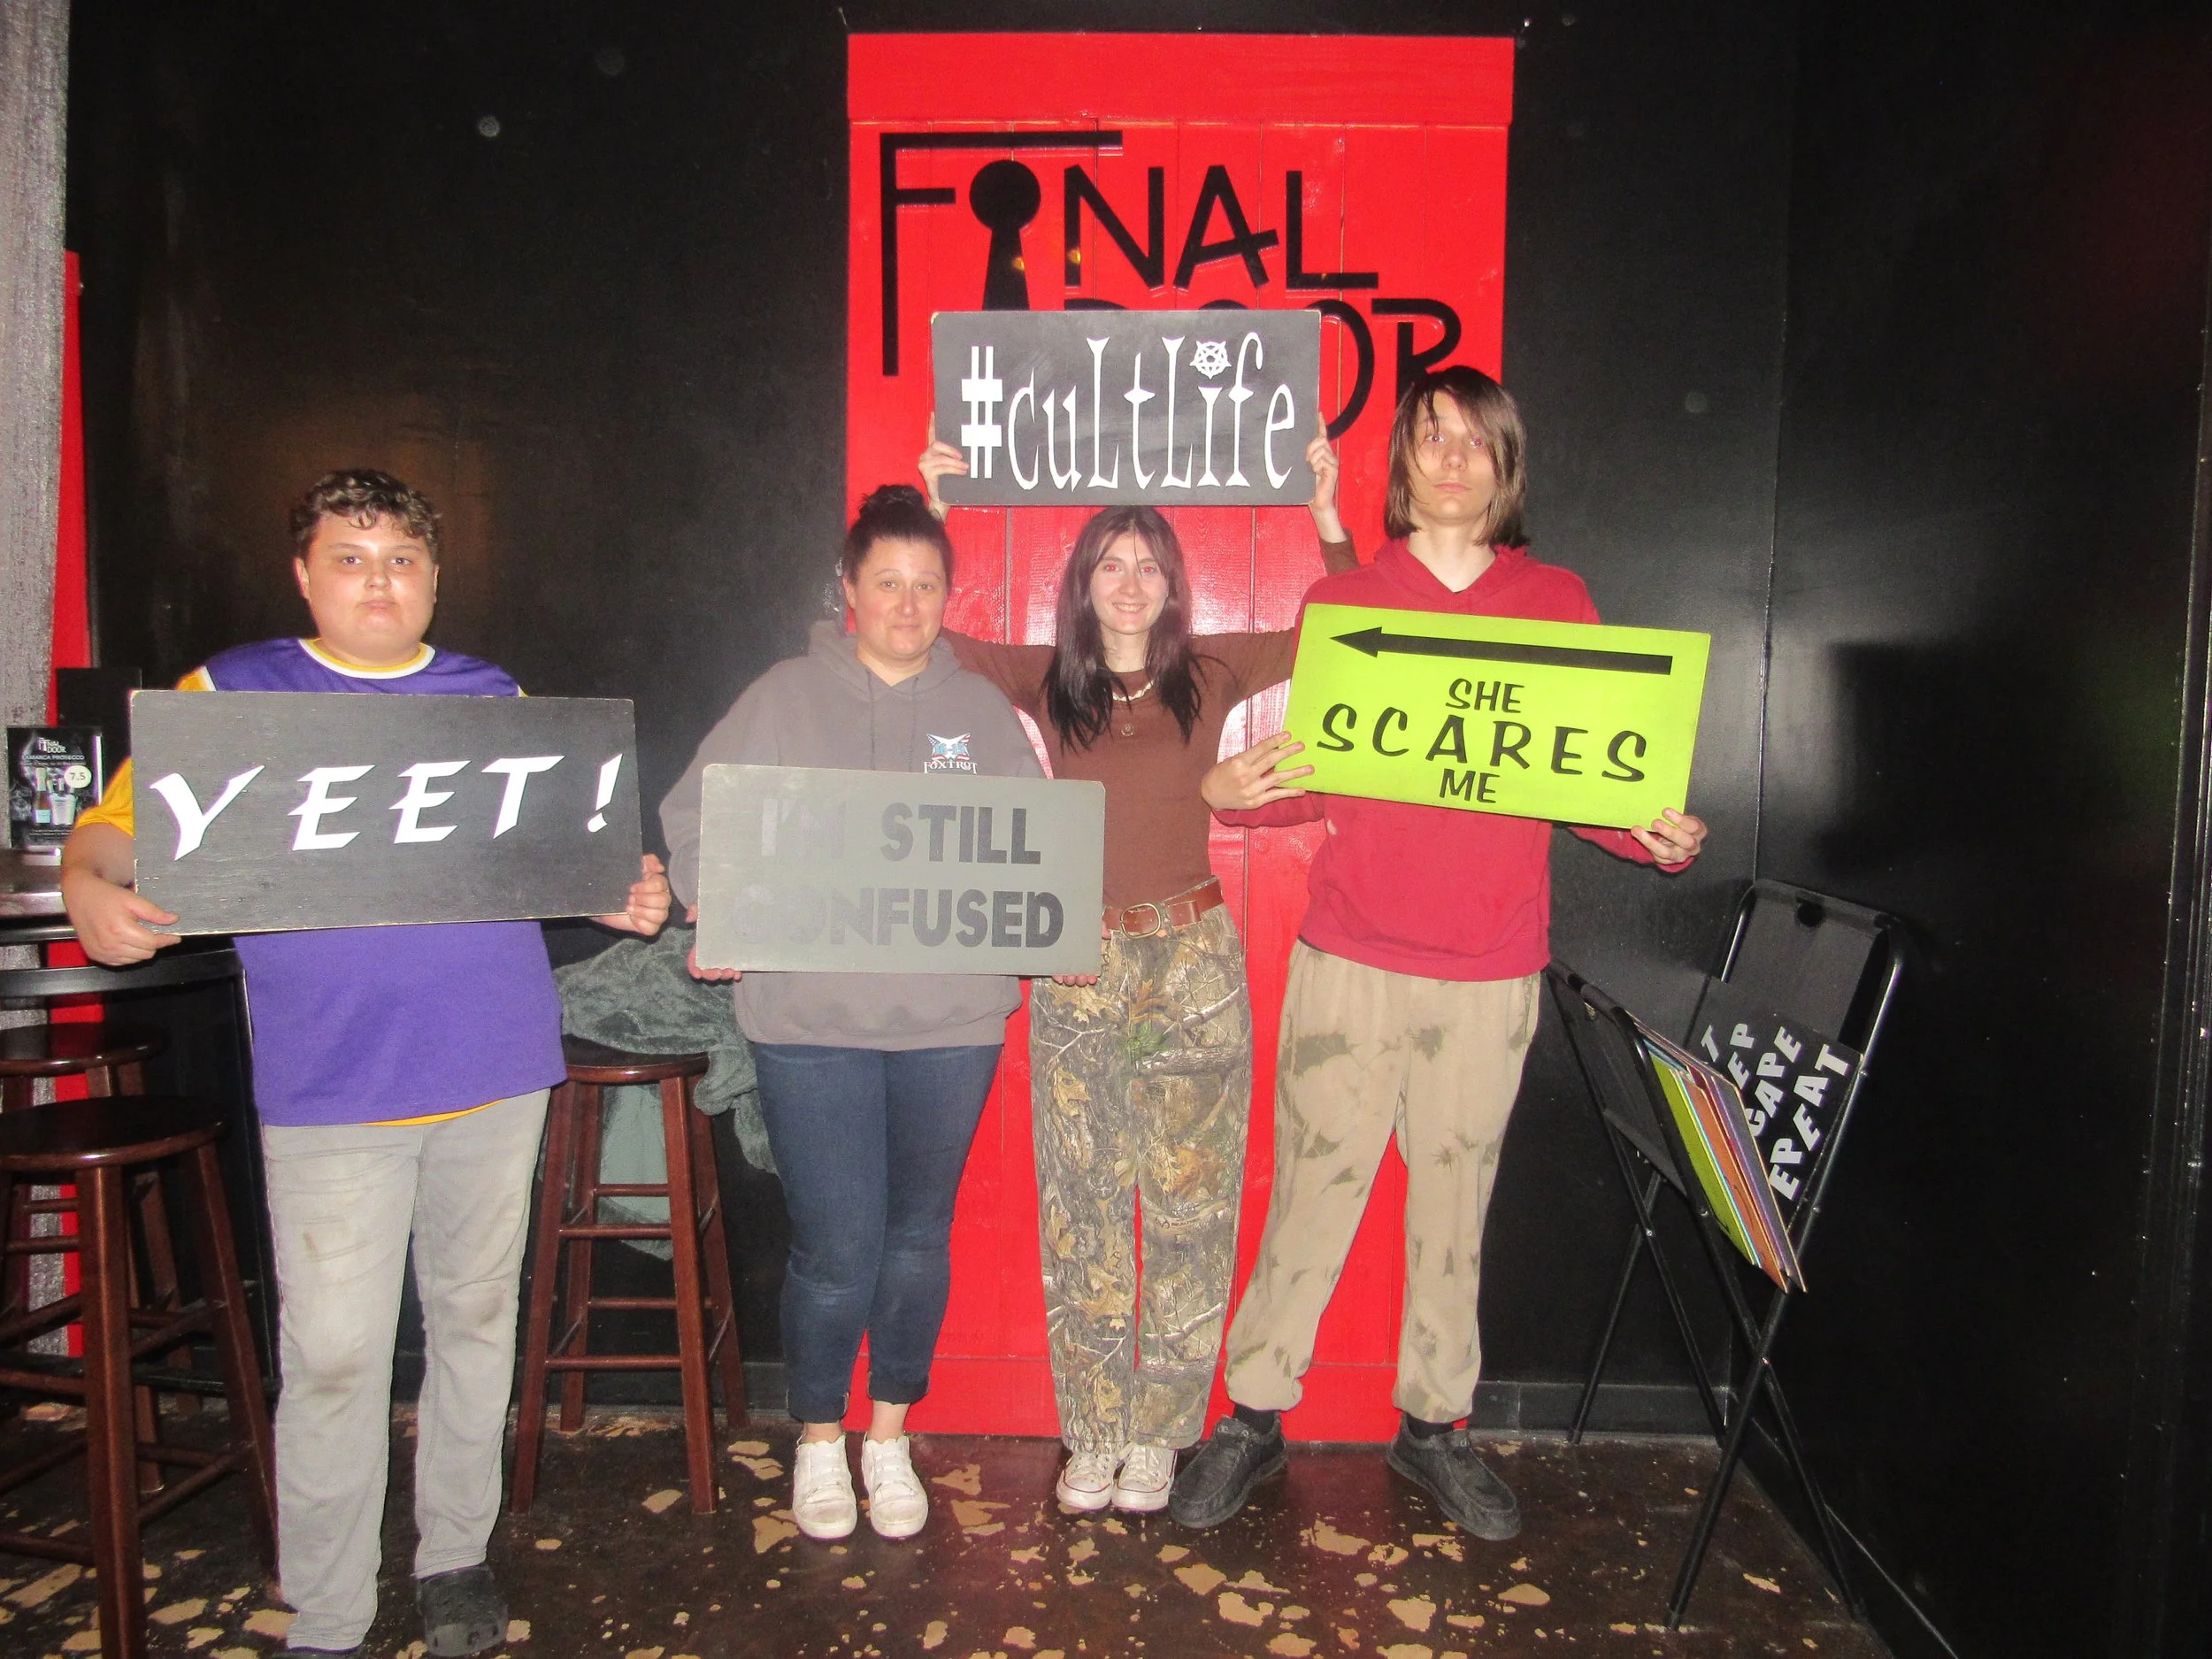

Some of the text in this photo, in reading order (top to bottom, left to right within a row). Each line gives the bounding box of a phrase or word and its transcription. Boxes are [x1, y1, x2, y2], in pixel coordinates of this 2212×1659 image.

[879, 130, 1379, 376] FINAL
[1446, 678, 1525, 714] SHE
[924, 760, 978, 775] FOXTROT
[1317, 703, 1647, 782] SCARES
[1439, 769, 1500, 804] ME
[761, 798, 1041, 864] I'M STILL
[730, 884, 1064, 949] CONFUSED
[1745, 1026, 1802, 1138] CAPE
[1768, 1044, 1849, 1201] EPEAT
